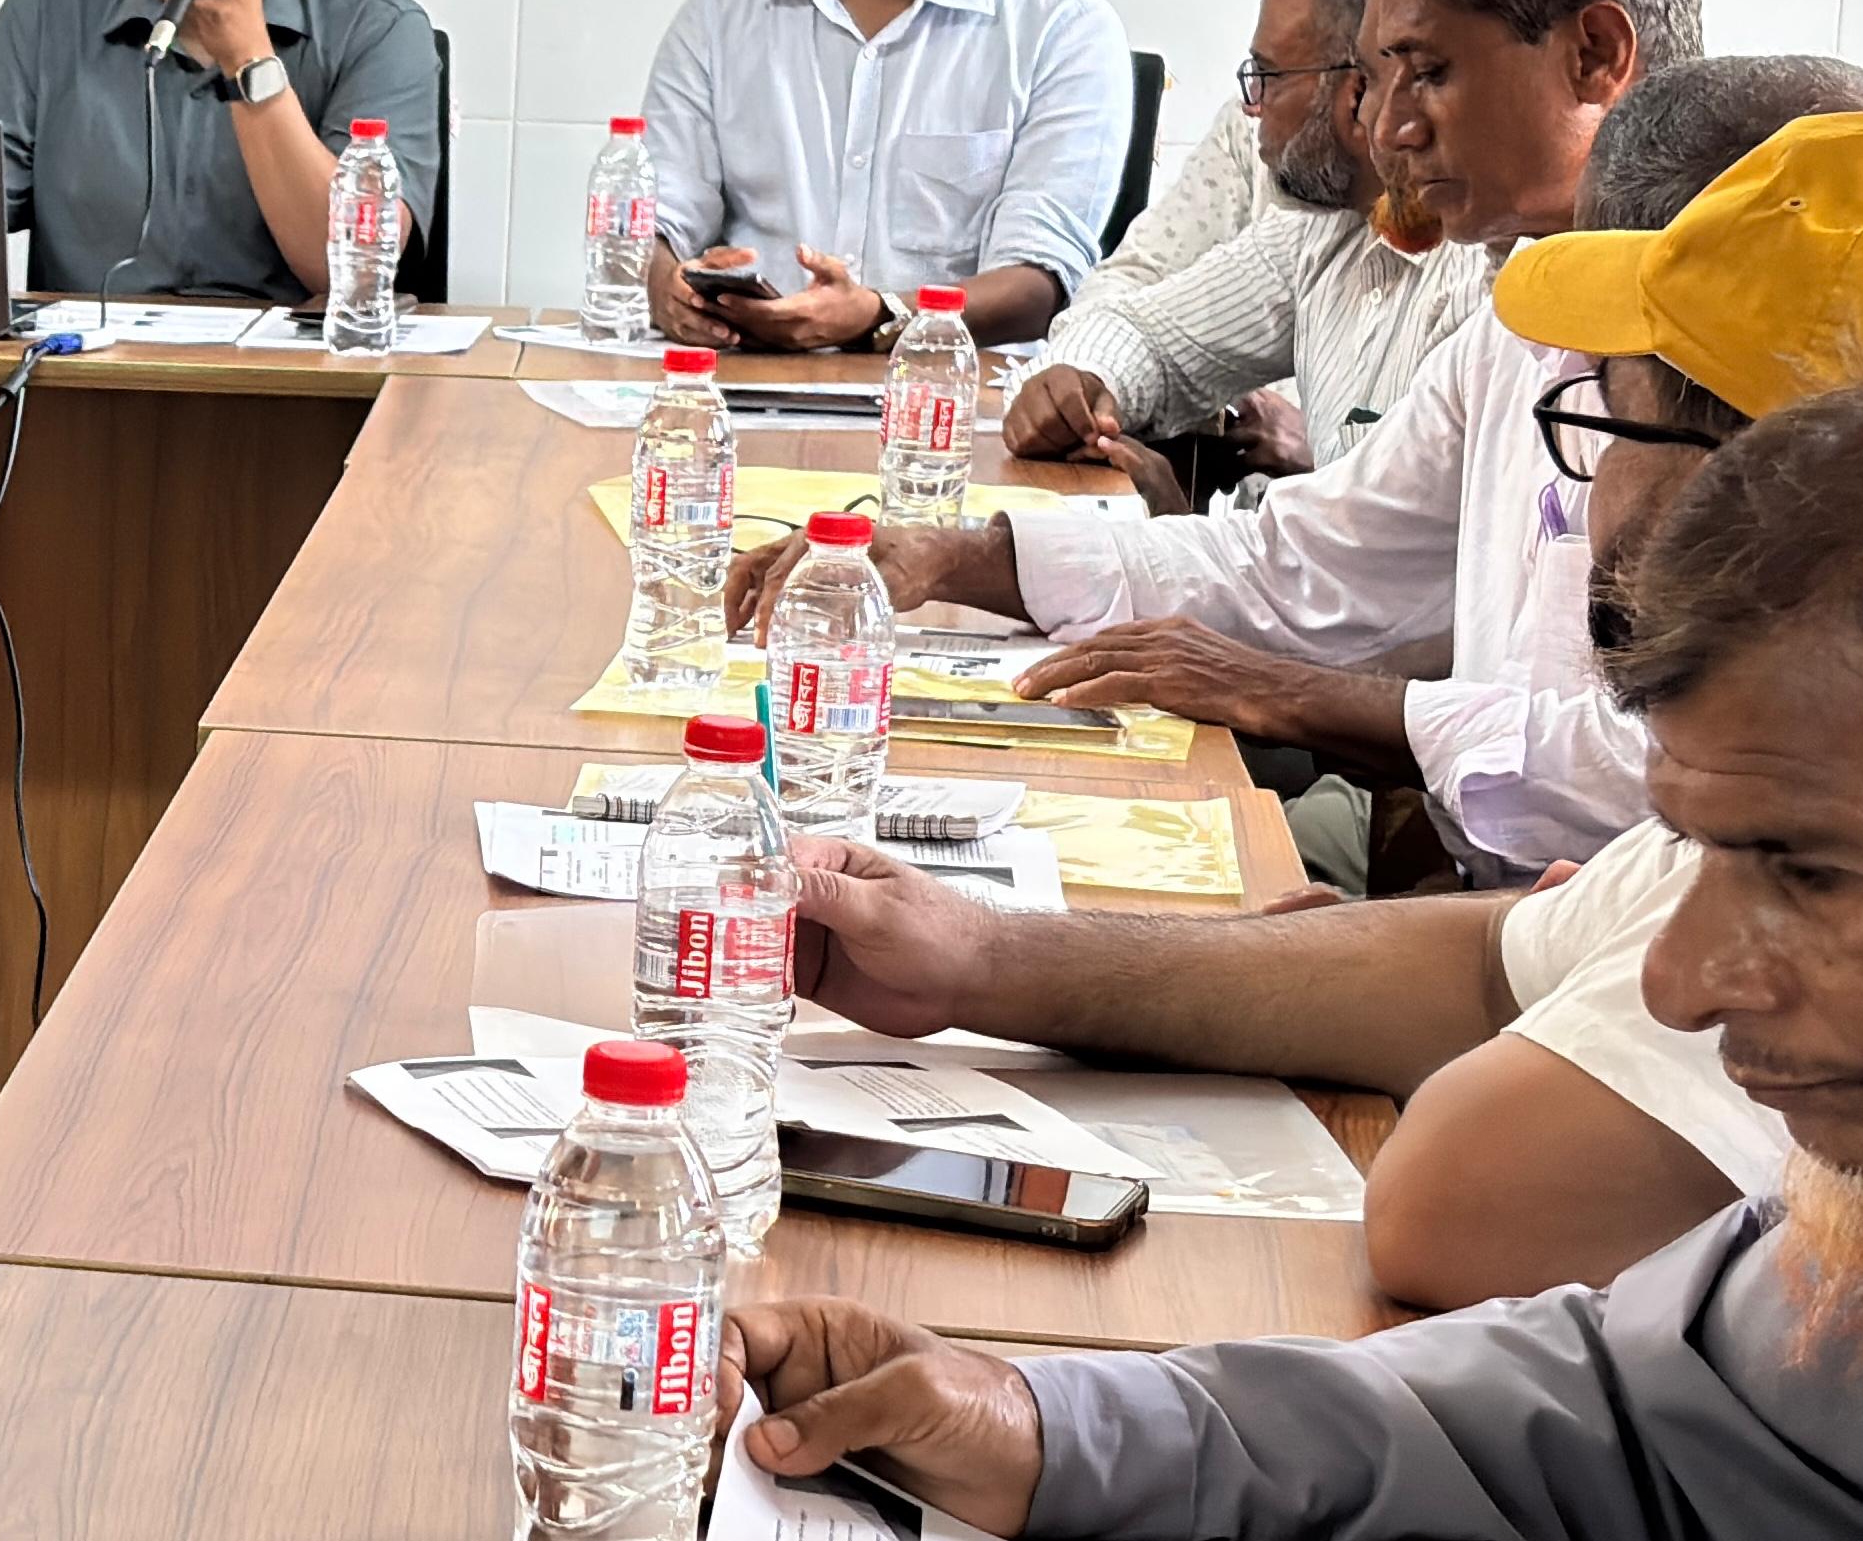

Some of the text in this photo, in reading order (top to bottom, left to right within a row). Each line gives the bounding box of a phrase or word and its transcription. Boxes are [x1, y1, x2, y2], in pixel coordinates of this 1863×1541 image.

[792, 664, 817, 731] জীবন
[679, 913, 710, 998] Jibon
[522, 1287, 549, 1394] জীবন
[658, 1305, 696, 1413] Jibon
